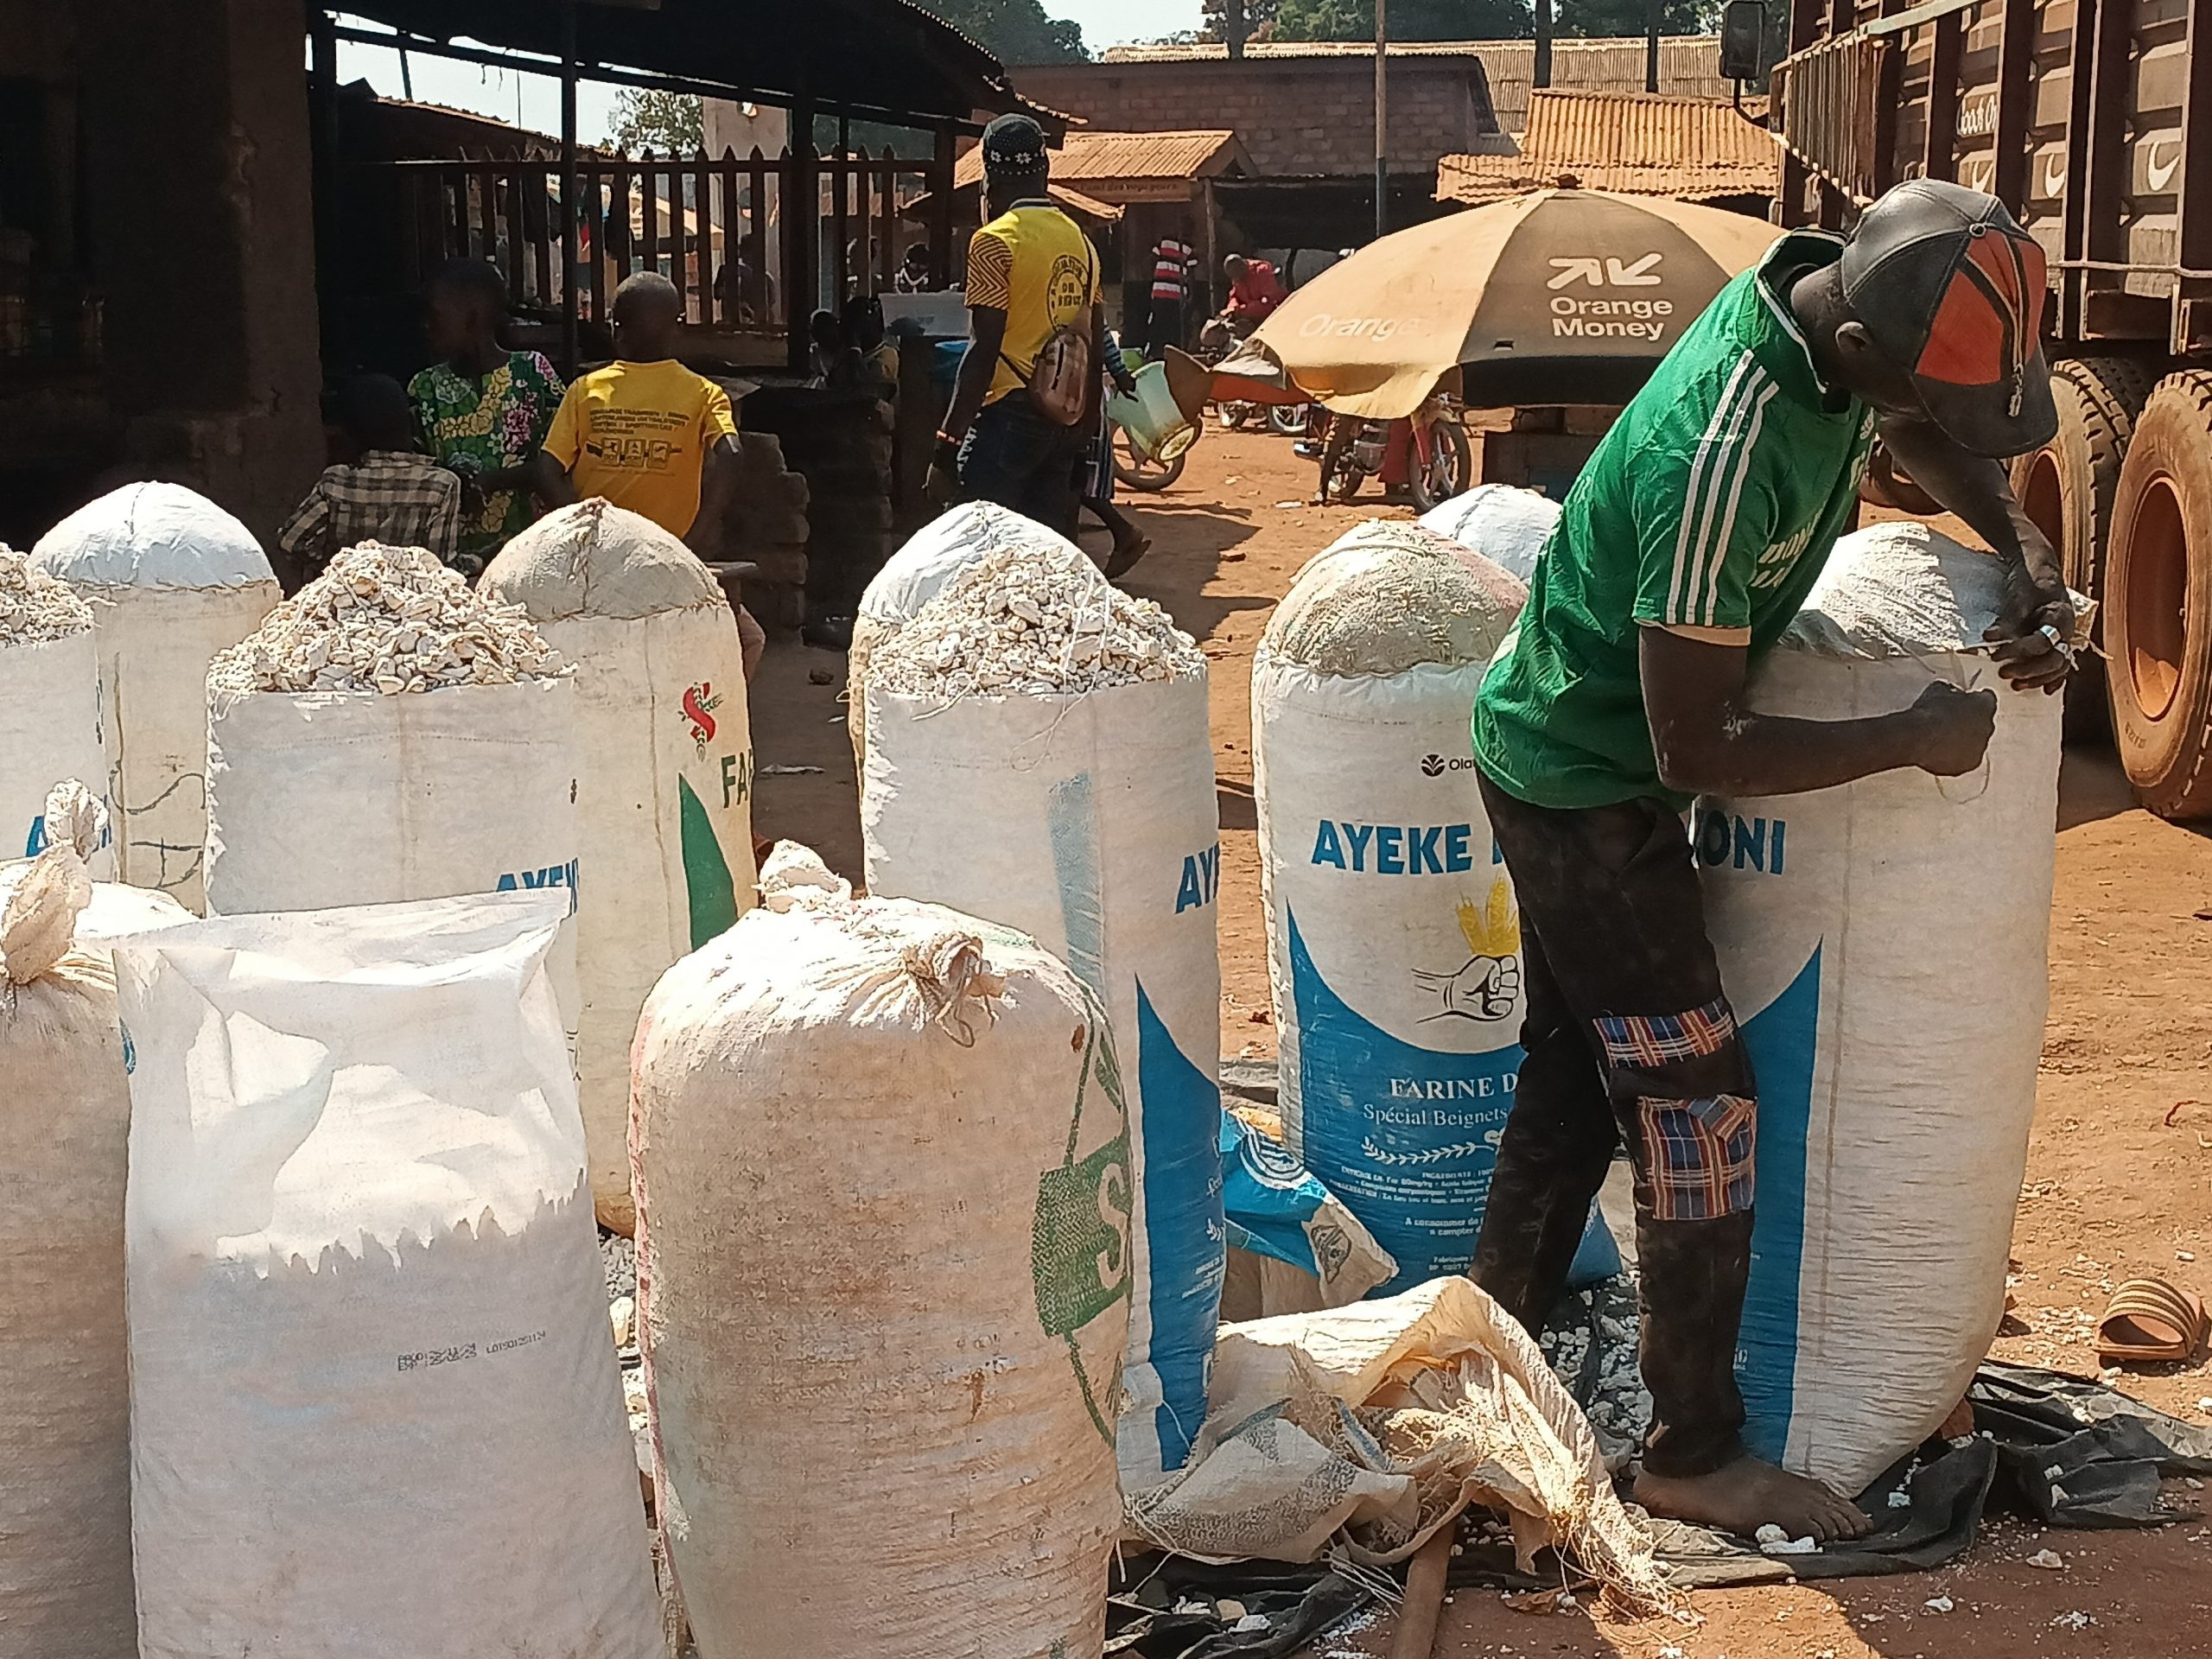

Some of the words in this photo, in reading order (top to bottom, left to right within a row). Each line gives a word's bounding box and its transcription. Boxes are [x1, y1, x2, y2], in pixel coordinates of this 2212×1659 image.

[1550, 296, 1673, 318] Orange
[1553, 318, 1665, 340] Money
[1449, 758, 1475, 771] Ola
[1311, 819, 1472, 874] AYEKE
[1703, 810, 1786, 875] ONI
[1389, 1077, 1495, 1100] FARINE
[1503, 1072, 1518, 1093] D
[1363, 1104, 1427, 1126] Spécial
[1433, 1106, 1508, 1128] Beignets
